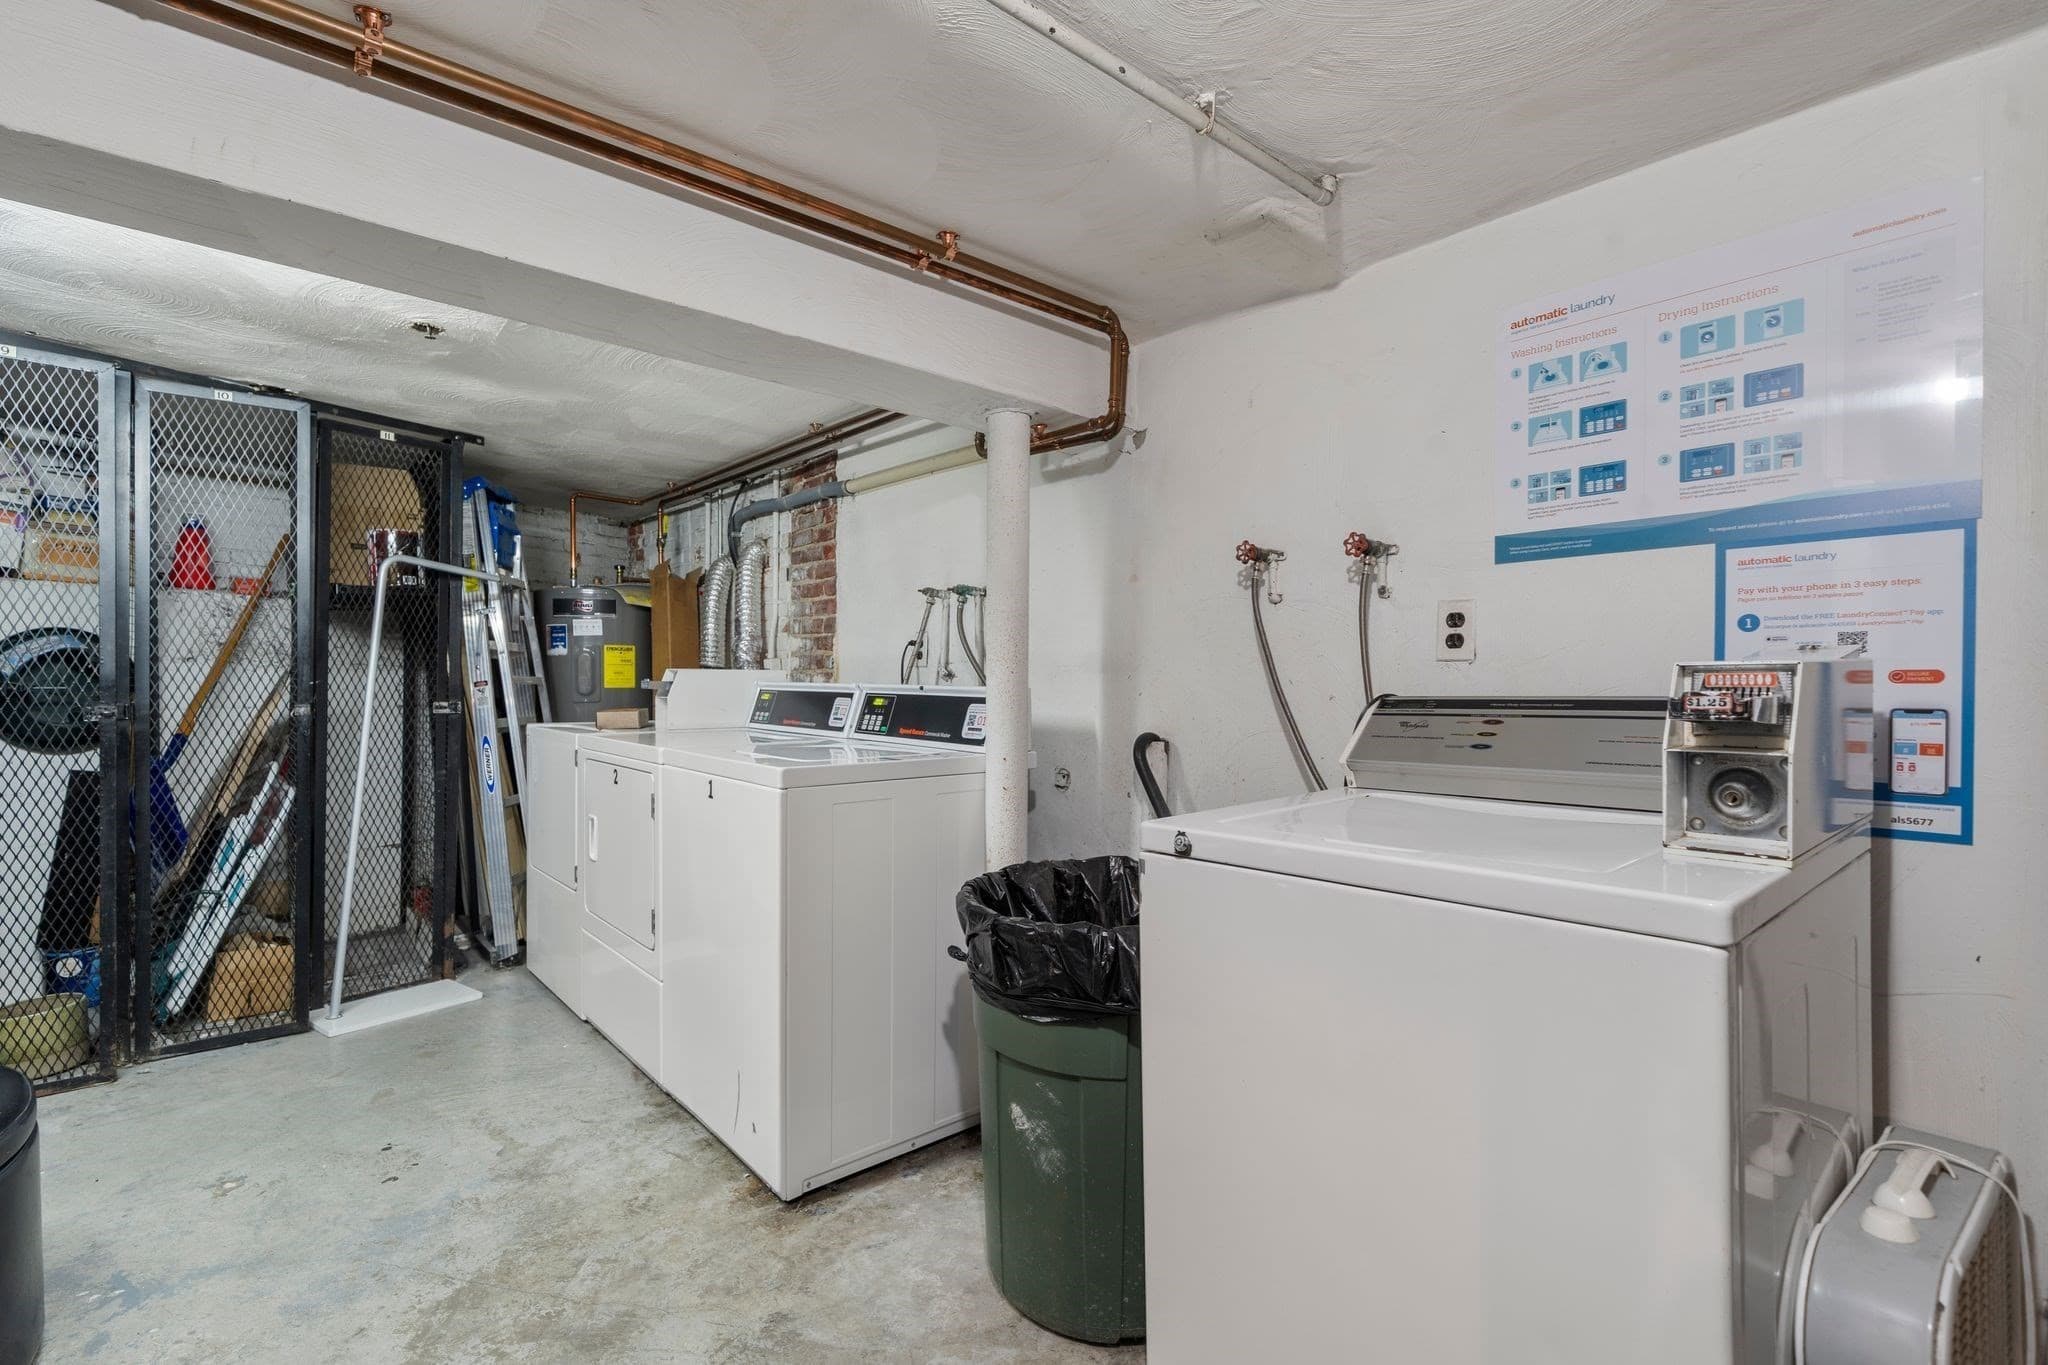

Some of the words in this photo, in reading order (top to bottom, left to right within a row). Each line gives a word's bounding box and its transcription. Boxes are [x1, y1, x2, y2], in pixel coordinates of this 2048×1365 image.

[1658, 305, 1698, 322] Drying
[1702, 285, 1779, 311] Instructions
[1510, 307, 1568, 330] automatic
[1570, 294, 1615, 313] laundry
[0, 345, 10, 355] 9
[1510, 343, 1553, 359] Washing
[1555, 326, 1617, 349] Instructions
[217, 391, 230, 400] 10
[1737, 554, 1793, 567] automatic
[1794, 551, 1837, 561] laundry
[1737, 587, 1755, 595] Pay
[1757, 585, 1779, 593] with
[1781, 585, 1805, 593] your
[1806, 583, 1838, 592] phone
[1840, 580, 1851, 589] in
[1854, 580, 1861, 588] 3
[1863, 579, 1888, 588] easy
[1745, 618, 1753, 628] 1
[1687, 697, 1728, 707] $1.25
[484, 747, 494, 781] WERNER
[613, 768, 619, 785] 2
[708, 779, 714, 800] 1
[1889, 815, 1934, 826] als5677
